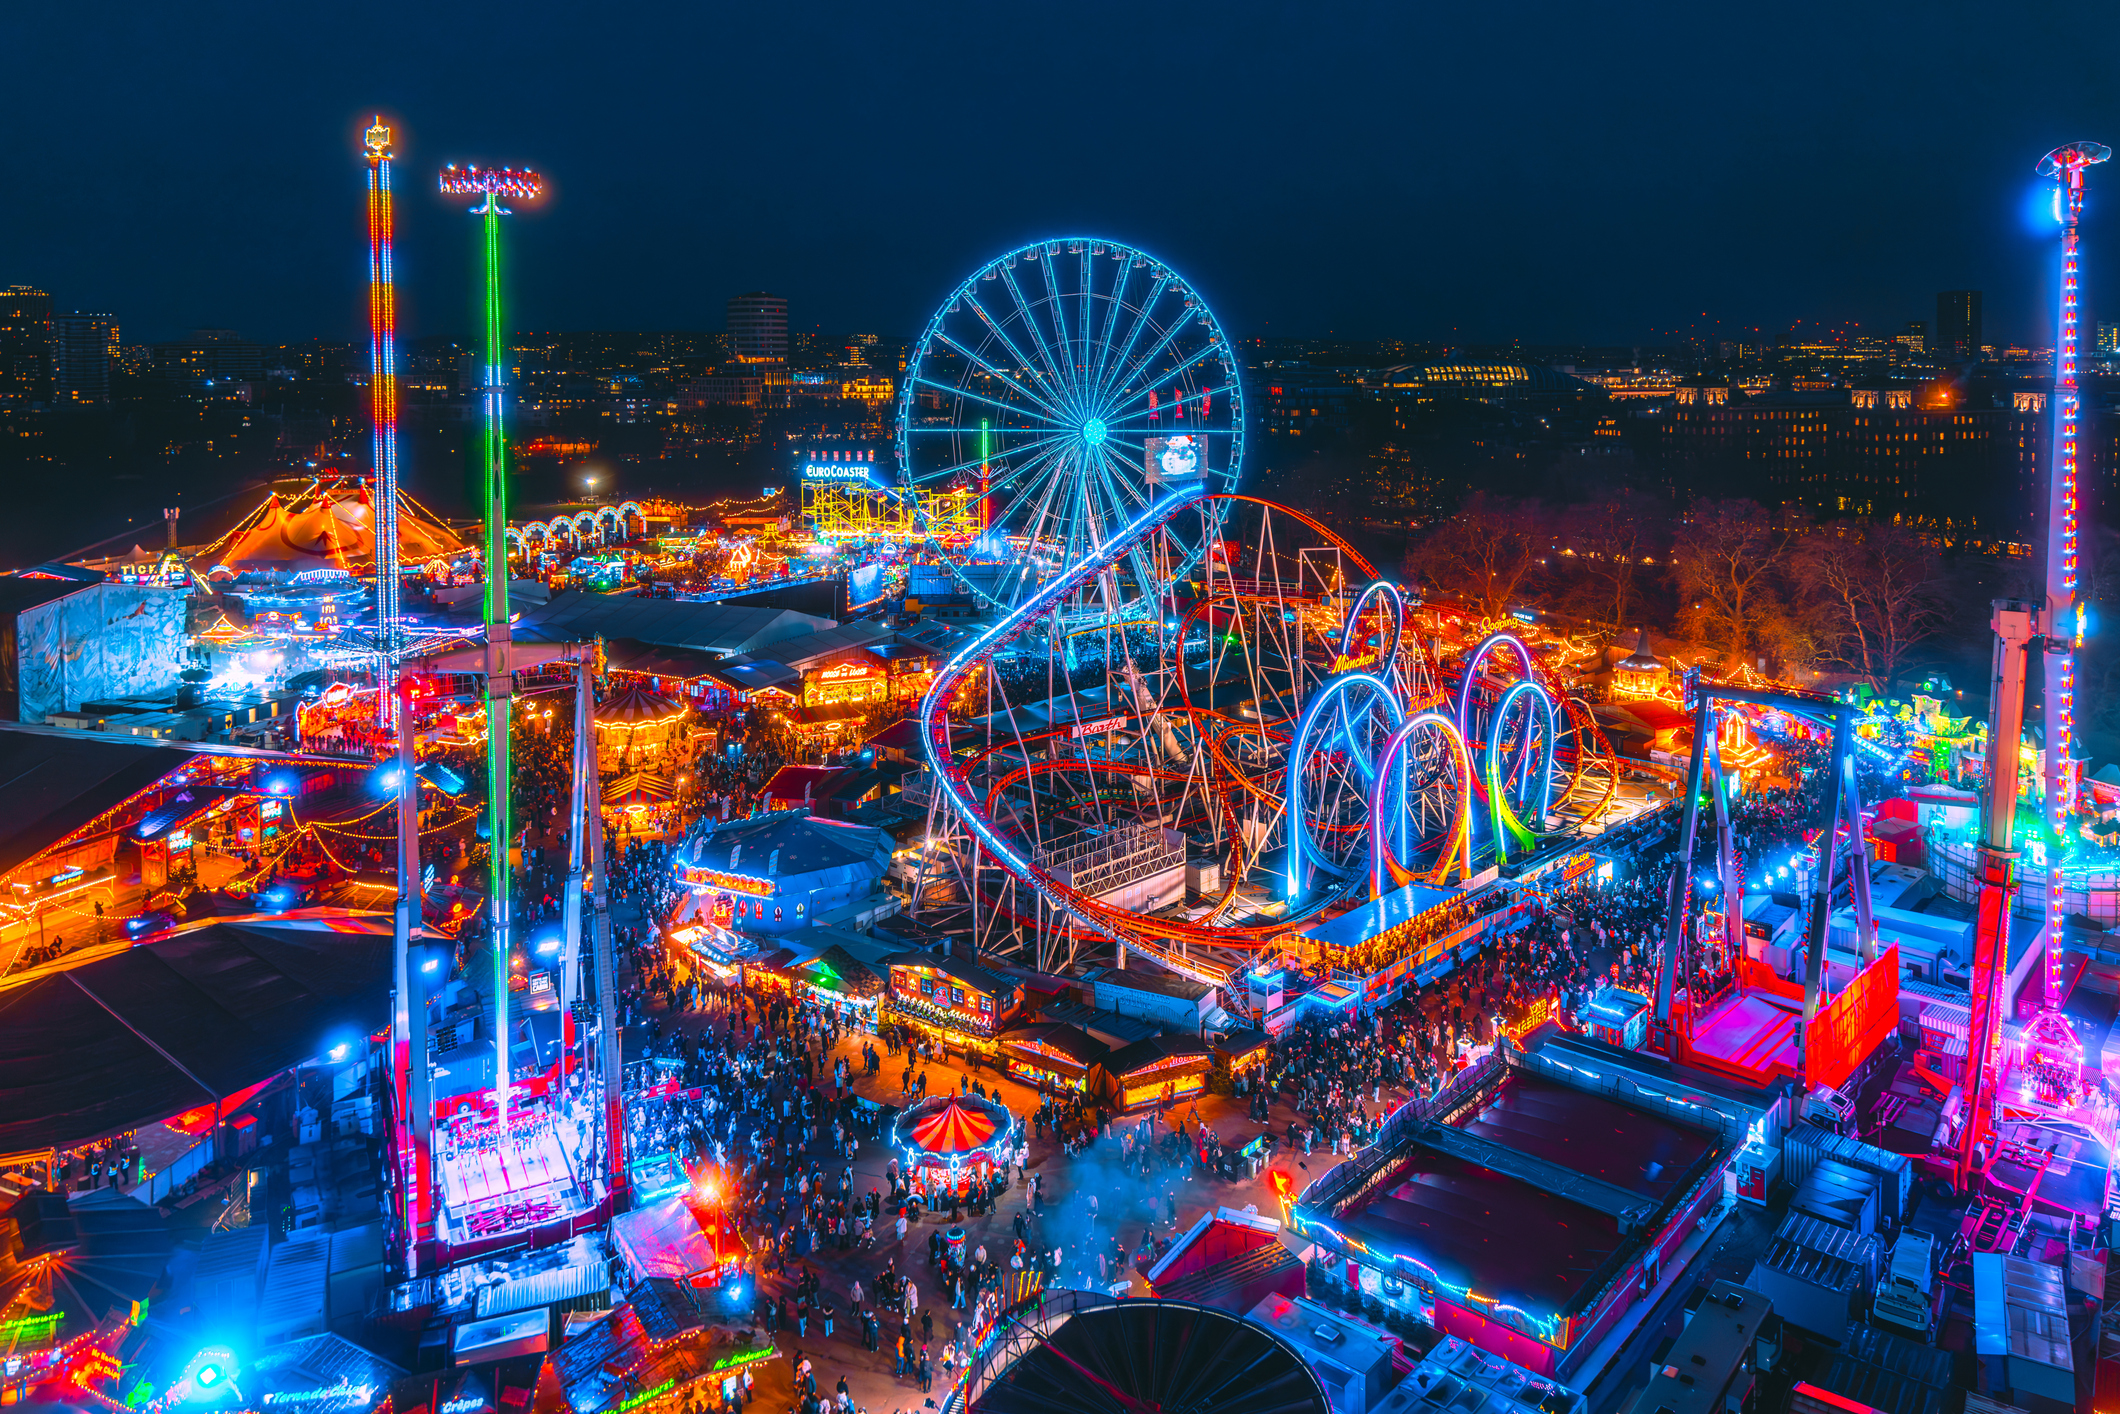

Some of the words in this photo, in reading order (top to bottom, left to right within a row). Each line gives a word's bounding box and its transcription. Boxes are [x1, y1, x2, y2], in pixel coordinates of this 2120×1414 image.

[121, 563, 185, 575] TICKTS
[1481, 612, 1518, 635] Looping
[1331, 651, 1375, 675] München
[1406, 686, 1445, 716] Barth
[1078, 717, 1121, 736] Barth
[1568, 851, 1591, 868] Kasse
[273, 1388, 328, 1404] Tornado
[443, 1397, 484, 1413] Crêpes
[619, 1378, 675, 1413] Bratwurst
